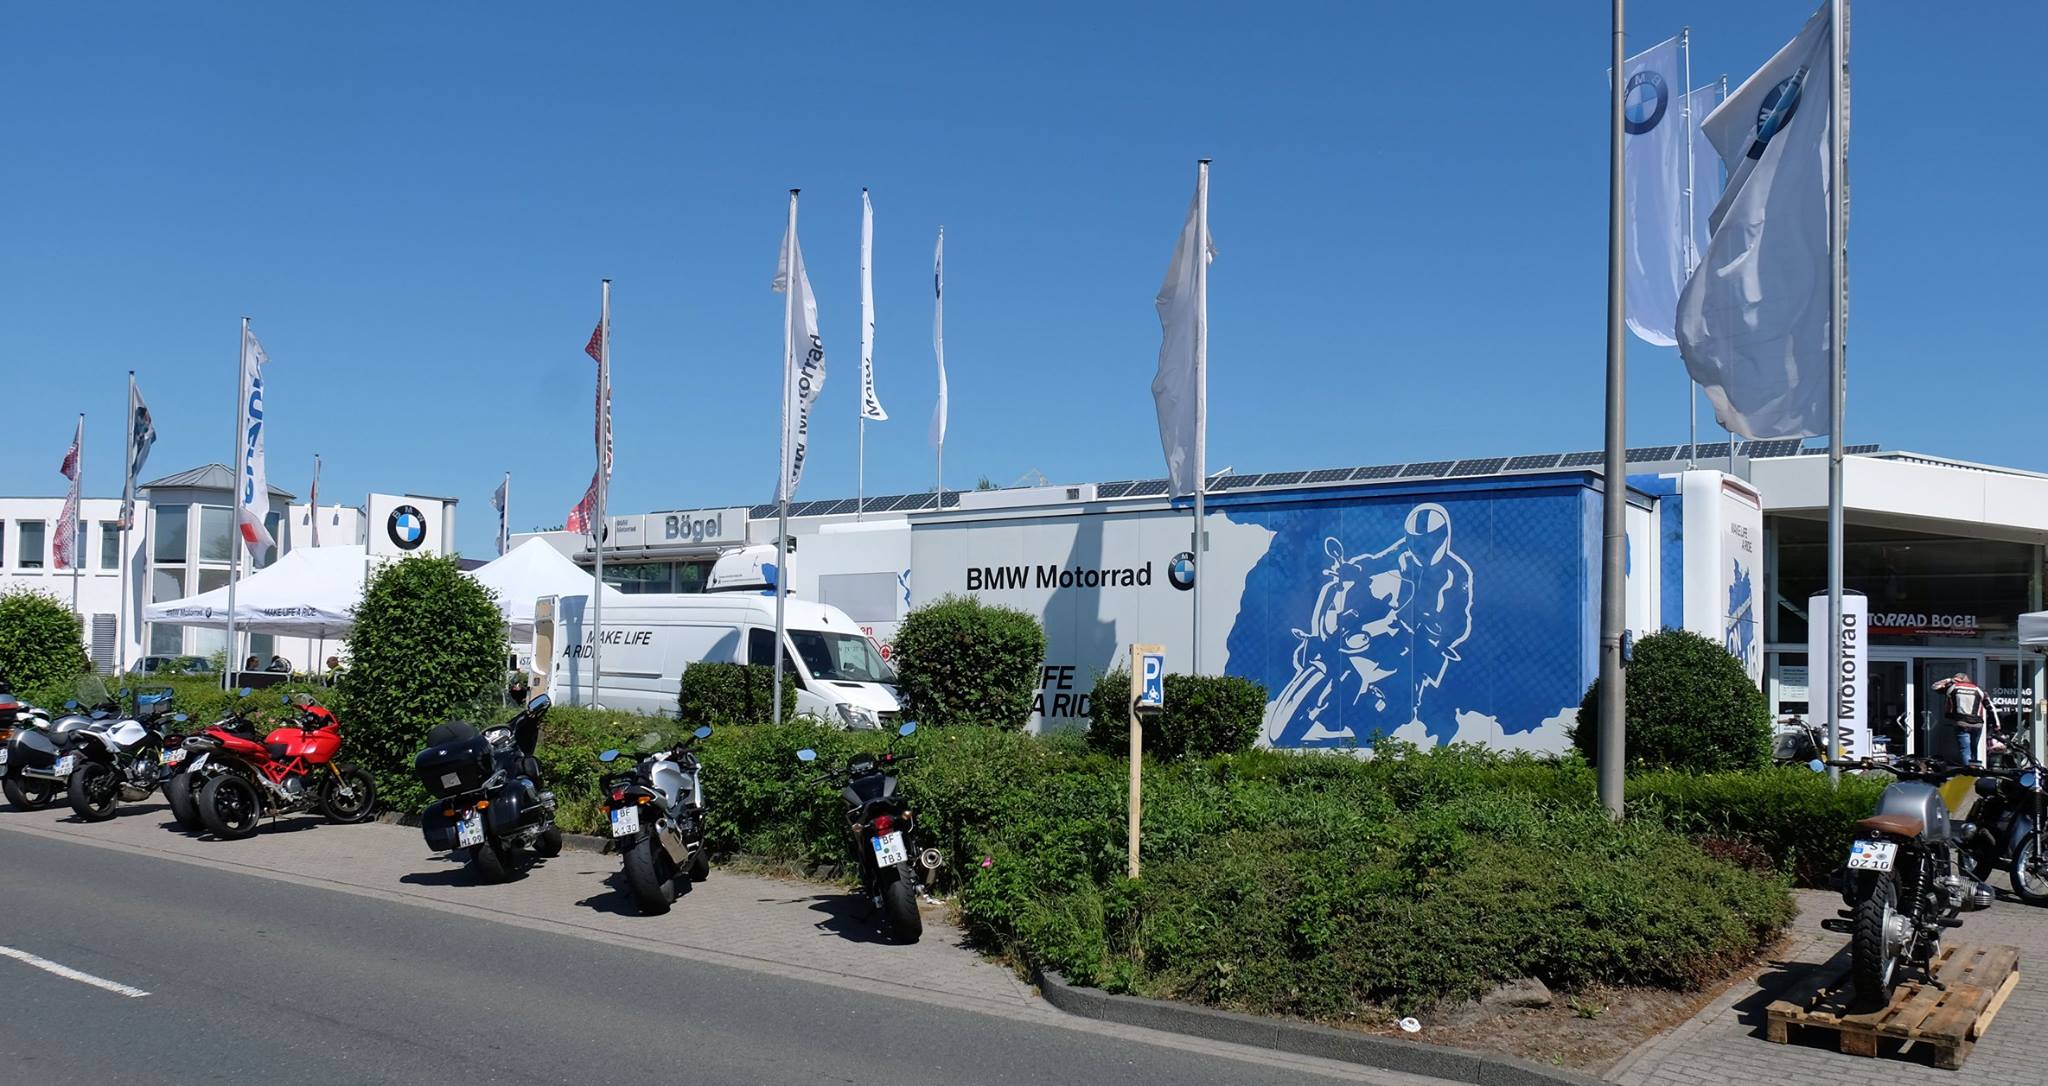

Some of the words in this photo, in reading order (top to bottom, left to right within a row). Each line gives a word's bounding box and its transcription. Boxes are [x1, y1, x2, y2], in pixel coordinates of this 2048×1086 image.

[665, 512, 722, 543] Bögel
[966, 565, 1030, 591] BMW
[1036, 561, 1152, 589] Motorrad
[1867, 612, 1927, 627] TORRAD
[624, 631, 653, 645] LIFE
[562, 644, 571, 658] A
[572, 644, 602, 658] RID
[1143, 657, 1160, 693] P
[1031, 693, 1046, 718] A
[1051, 693, 1090, 718] RID
[620, 808, 631, 818] BF
[882, 834, 894, 845] BF
[1869, 842, 1887, 852] ST
[881, 853, 895, 866] TB
